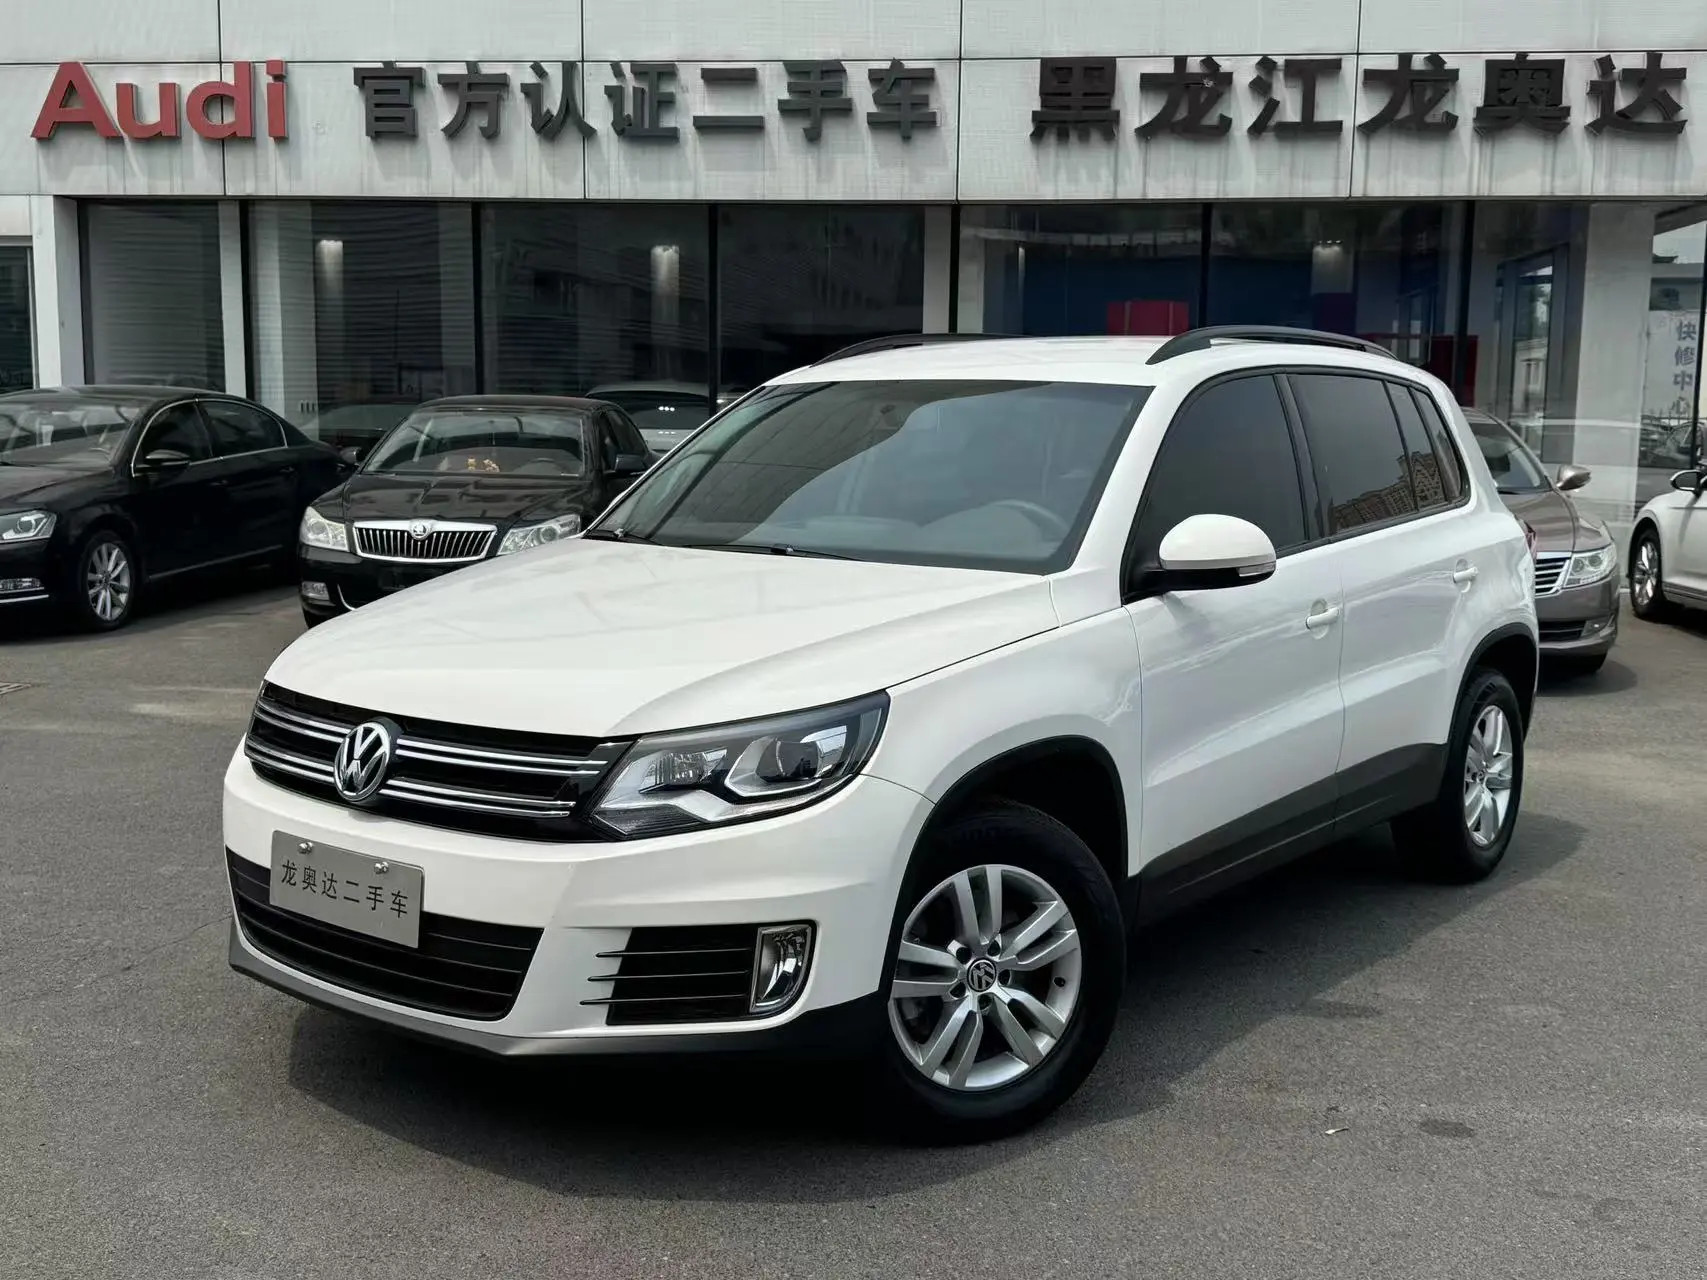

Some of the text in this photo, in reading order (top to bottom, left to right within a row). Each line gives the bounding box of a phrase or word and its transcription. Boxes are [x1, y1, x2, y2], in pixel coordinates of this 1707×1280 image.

[31, 59, 288, 140] Audi
[353, 59, 938, 141] 官方认证二手车
[1030, 52, 1688, 142] 黑龙江龙奥达
[1671, 319, 1697, 415] 快修中心
[280, 858, 409, 919] 龙奥达二手车
